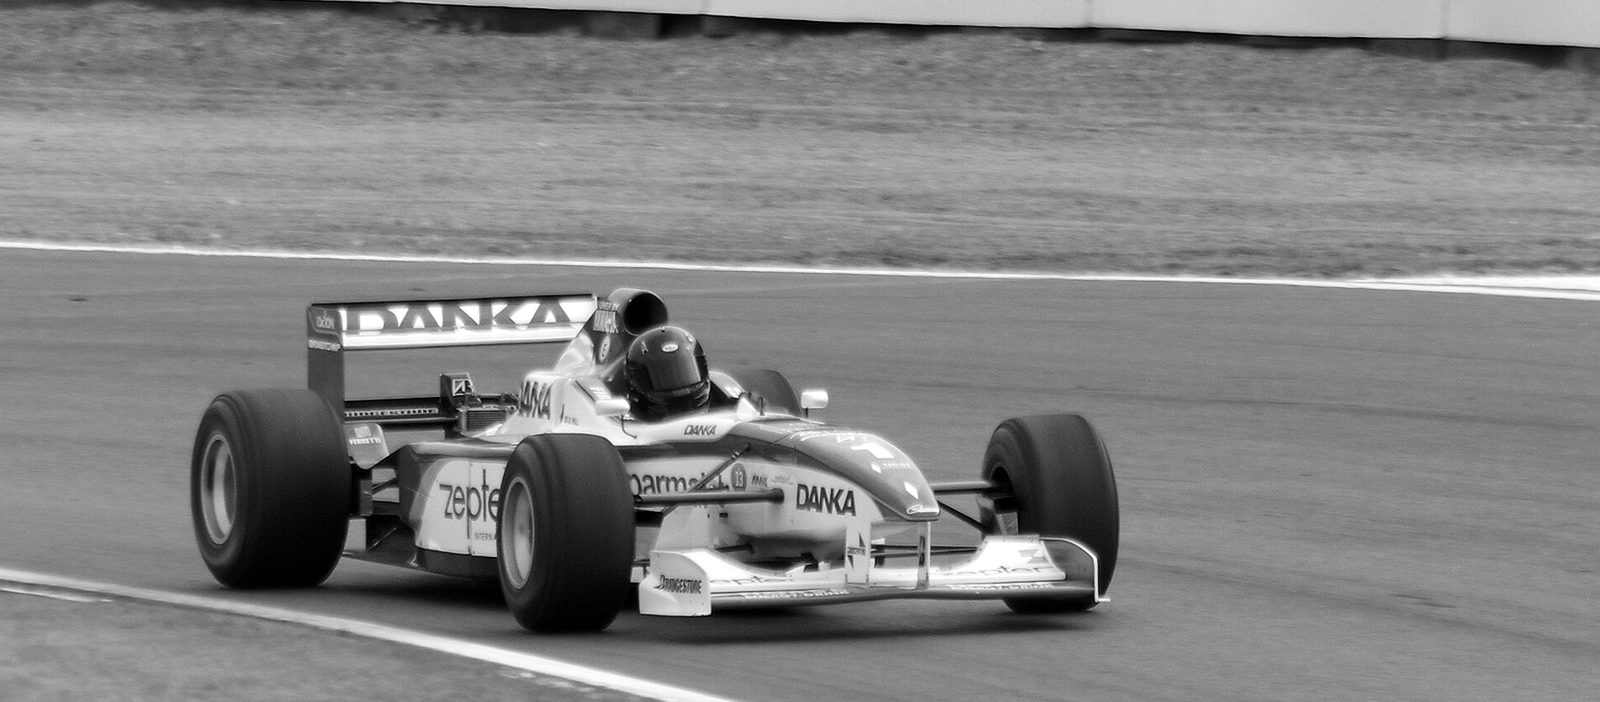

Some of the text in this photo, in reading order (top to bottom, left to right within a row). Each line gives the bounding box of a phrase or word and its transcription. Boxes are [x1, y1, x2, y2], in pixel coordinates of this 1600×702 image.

[346, 301, 573, 334] DANKA
[684, 424, 717, 436] DANKA
[796, 483, 857, 517] DANKA
[654, 574, 702, 594] BRIDGESTONE
